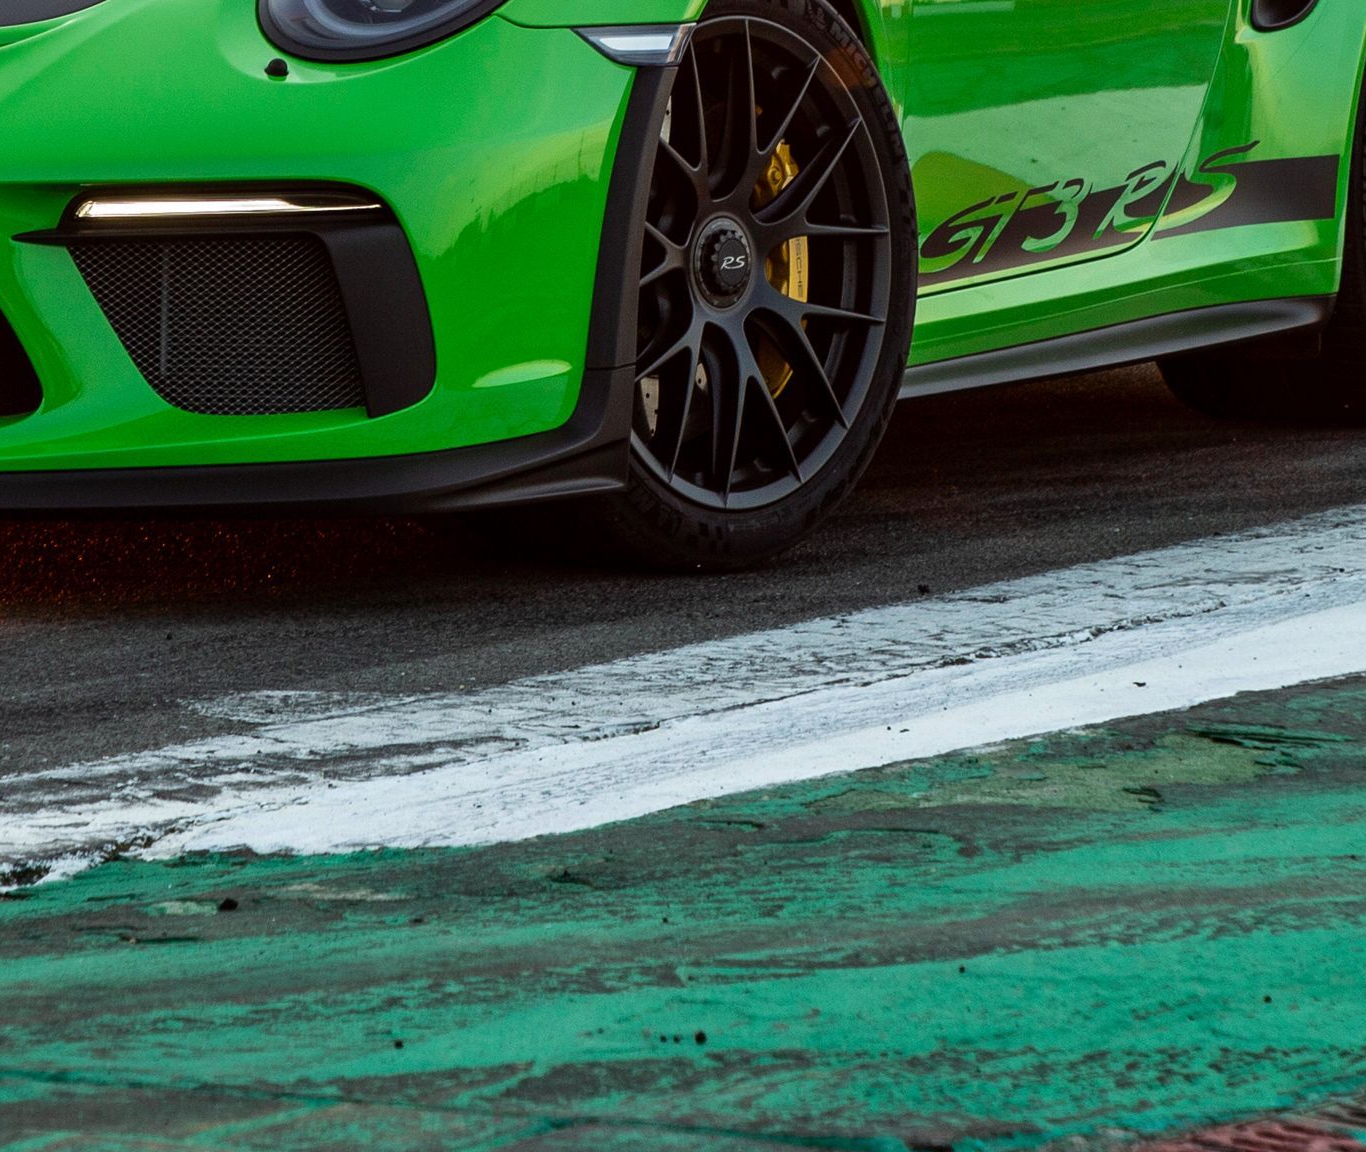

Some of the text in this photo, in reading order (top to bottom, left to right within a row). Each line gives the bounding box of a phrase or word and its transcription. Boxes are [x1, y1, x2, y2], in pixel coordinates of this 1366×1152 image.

[918, 134, 1261, 273] GT3 RS
[720, 255, 746, 270] RS
